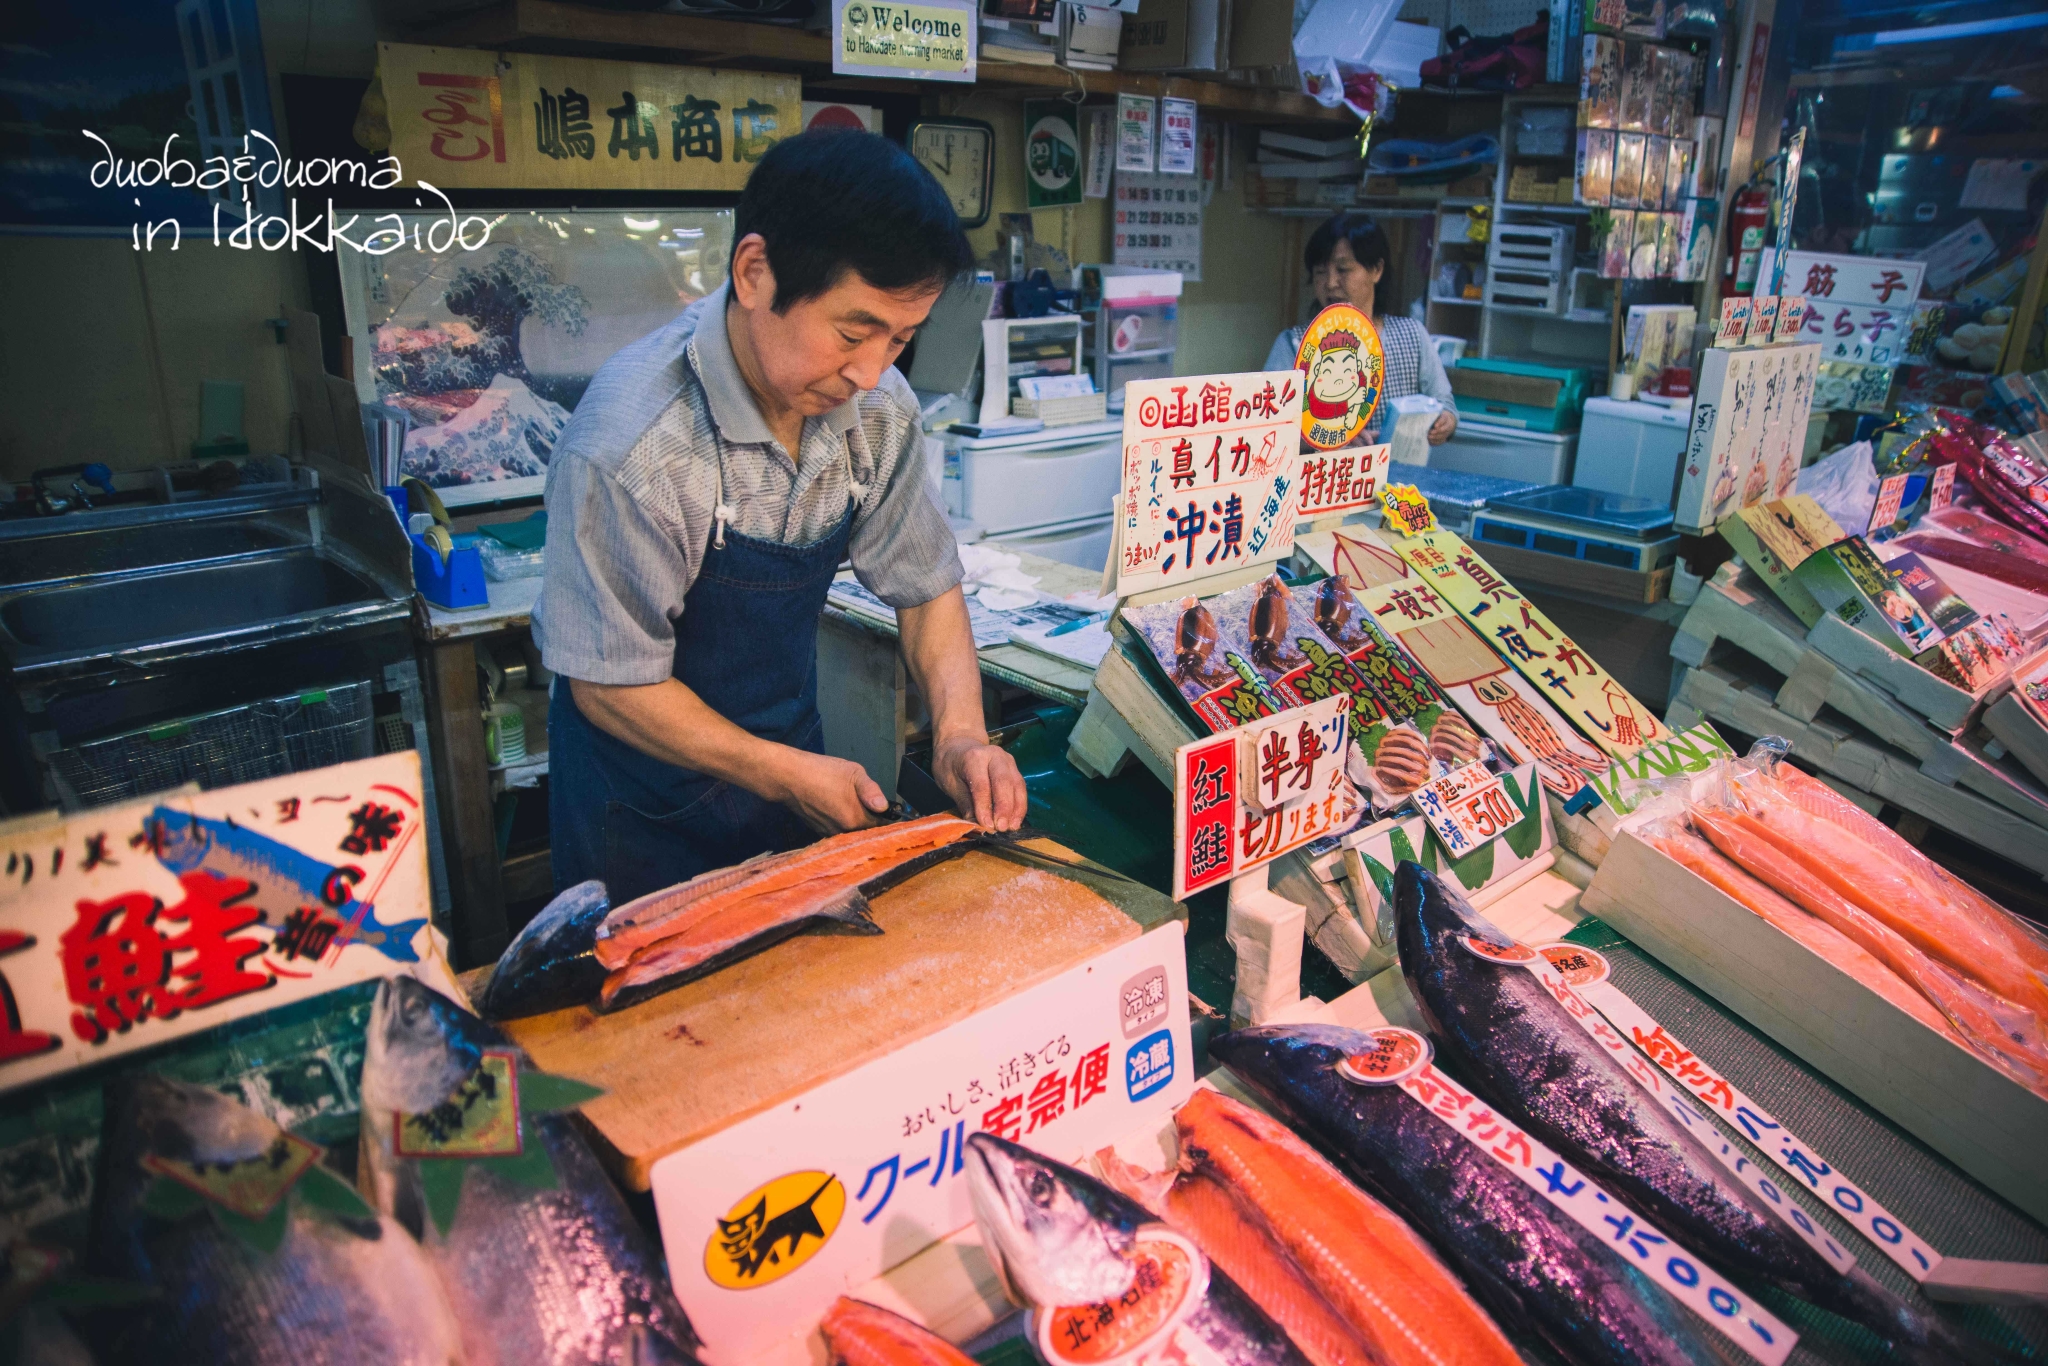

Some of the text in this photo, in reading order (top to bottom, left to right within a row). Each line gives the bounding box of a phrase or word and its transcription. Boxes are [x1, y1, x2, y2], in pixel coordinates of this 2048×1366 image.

[872, 6, 961, 38] Welcome
[846, 35, 964, 61] to Hakodate morning market
[533, 86, 780, 165] 嶋本商店
[930, 133, 939, 147] 11
[963, 135, 968, 148] 1
[972, 150, 978, 162] 2
[1769, 263, 1907, 303] 筋子
[1801, 303, 1897, 343] たら子
[1308, 422, 1347, 447] 函館朝市
[1170, 436, 1252, 490] 真イカ
[1161, 491, 1244, 575] 沖漬
[1247, 474, 1292, 556] 近海産
[1374, 584, 1443, 621] 一夜干
[1452, 552, 1598, 677] 真イカ
[1469, 599, 1612, 732] 一夜干し
[1261, 721, 1323, 801] 半身
[1192, 759, 1231, 877] 紅鮭
[1417, 788, 1470, 850] 沖漬
[1124, 975, 1165, 1018] 冷凍
[1137, 1008, 1156, 1024] タイプ
[1129, 1038, 1171, 1082] 冷蔵
[1142, 1073, 1161, 1088] タイプ
[902, 1034, 1071, 1137] おいしさ、活きてる
